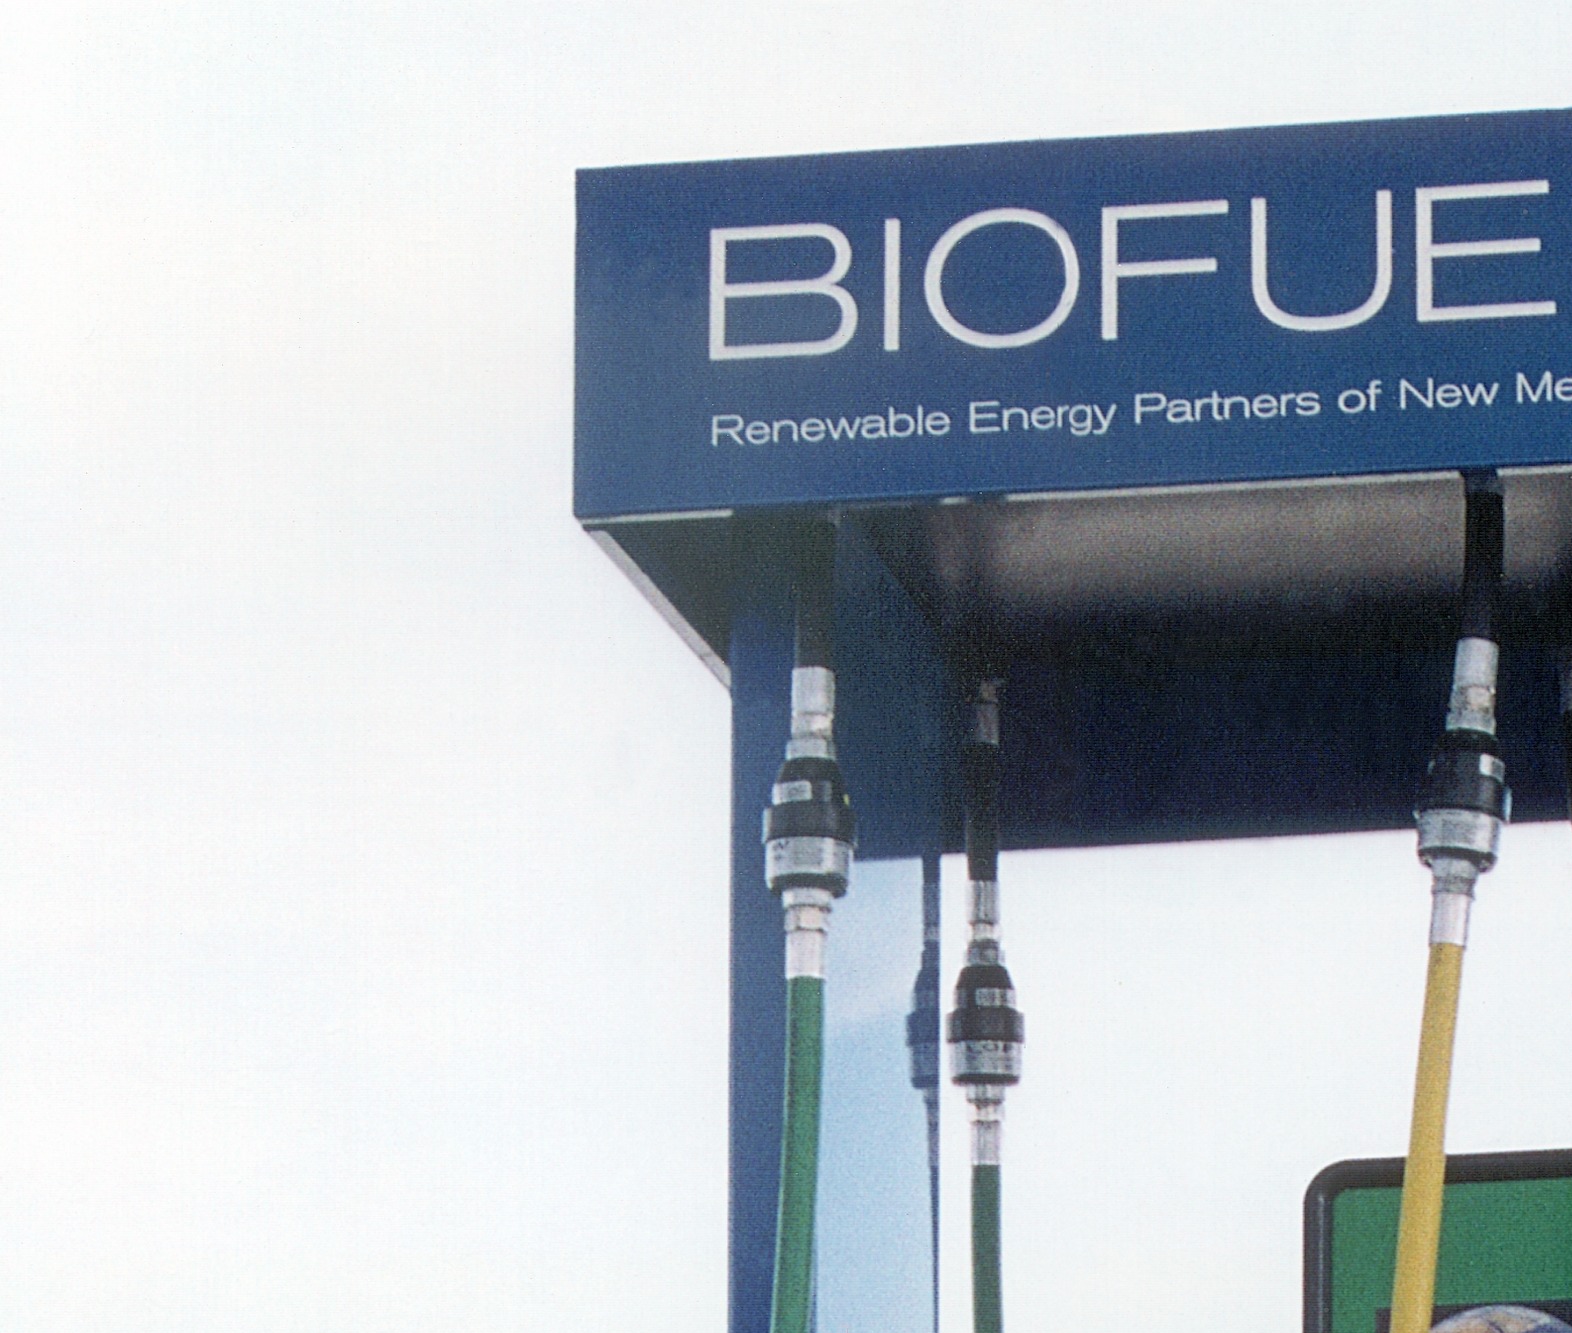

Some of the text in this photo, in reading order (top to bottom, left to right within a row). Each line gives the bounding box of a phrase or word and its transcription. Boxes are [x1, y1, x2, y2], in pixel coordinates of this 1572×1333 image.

[711, 405, 951, 446] Renewable
[969, 401, 1117, 435] Energy
[1134, 389, 1321, 425] Partners
[1338, 380, 1382, 414] of
[1399, 377, 1499, 410] New
